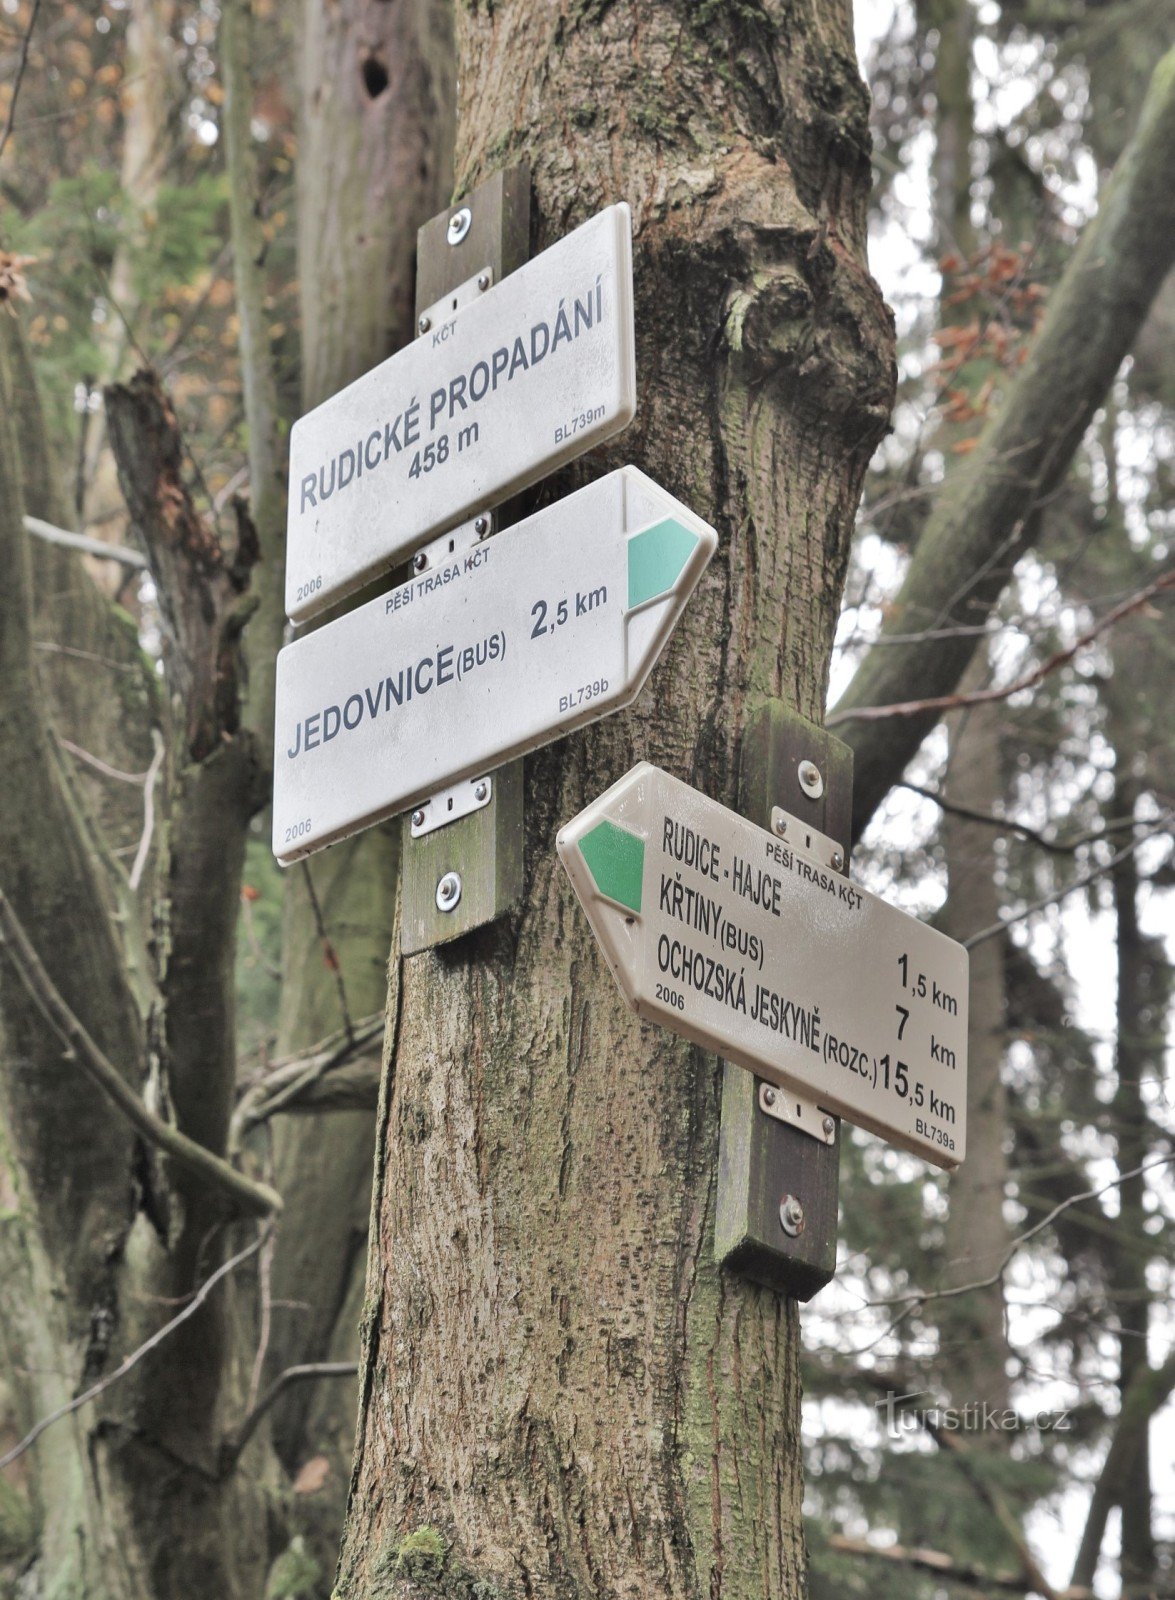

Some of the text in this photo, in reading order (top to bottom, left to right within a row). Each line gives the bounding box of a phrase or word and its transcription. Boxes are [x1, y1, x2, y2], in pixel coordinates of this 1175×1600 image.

[432, 320, 458, 349] KČT
[299, 274, 603, 514] RUDICKÉ PROPADÁNÍ
[408, 421, 480, 480] 458 m
[553, 403, 606, 445] BL739m
[296, 574, 323, 603] 2006
[385, 546, 491, 615] PĚŠÍ TRASA KČT
[530, 599, 569, 641] 2,5
[575, 584, 608, 618] km
[558, 678, 610, 714] BL739b
[284, 818, 312, 845] 2006
[662, 815, 721, 883] RUDICE
[732, 854, 782, 917] HAJCE
[765, 841, 794, 873] PĚŠÍ
[797, 861, 836, 897] TRASA
[654, 982, 686, 1012] 2006
[896, 952, 958, 1017] 1,5 km
[657, 932, 957, 1125] OCHOZSKÁ JESKYNĚ (ROZC.) 15,5 km
[895, 1004, 957, 1071] 7 km
[914, 1117, 956, 1152] BL739a
